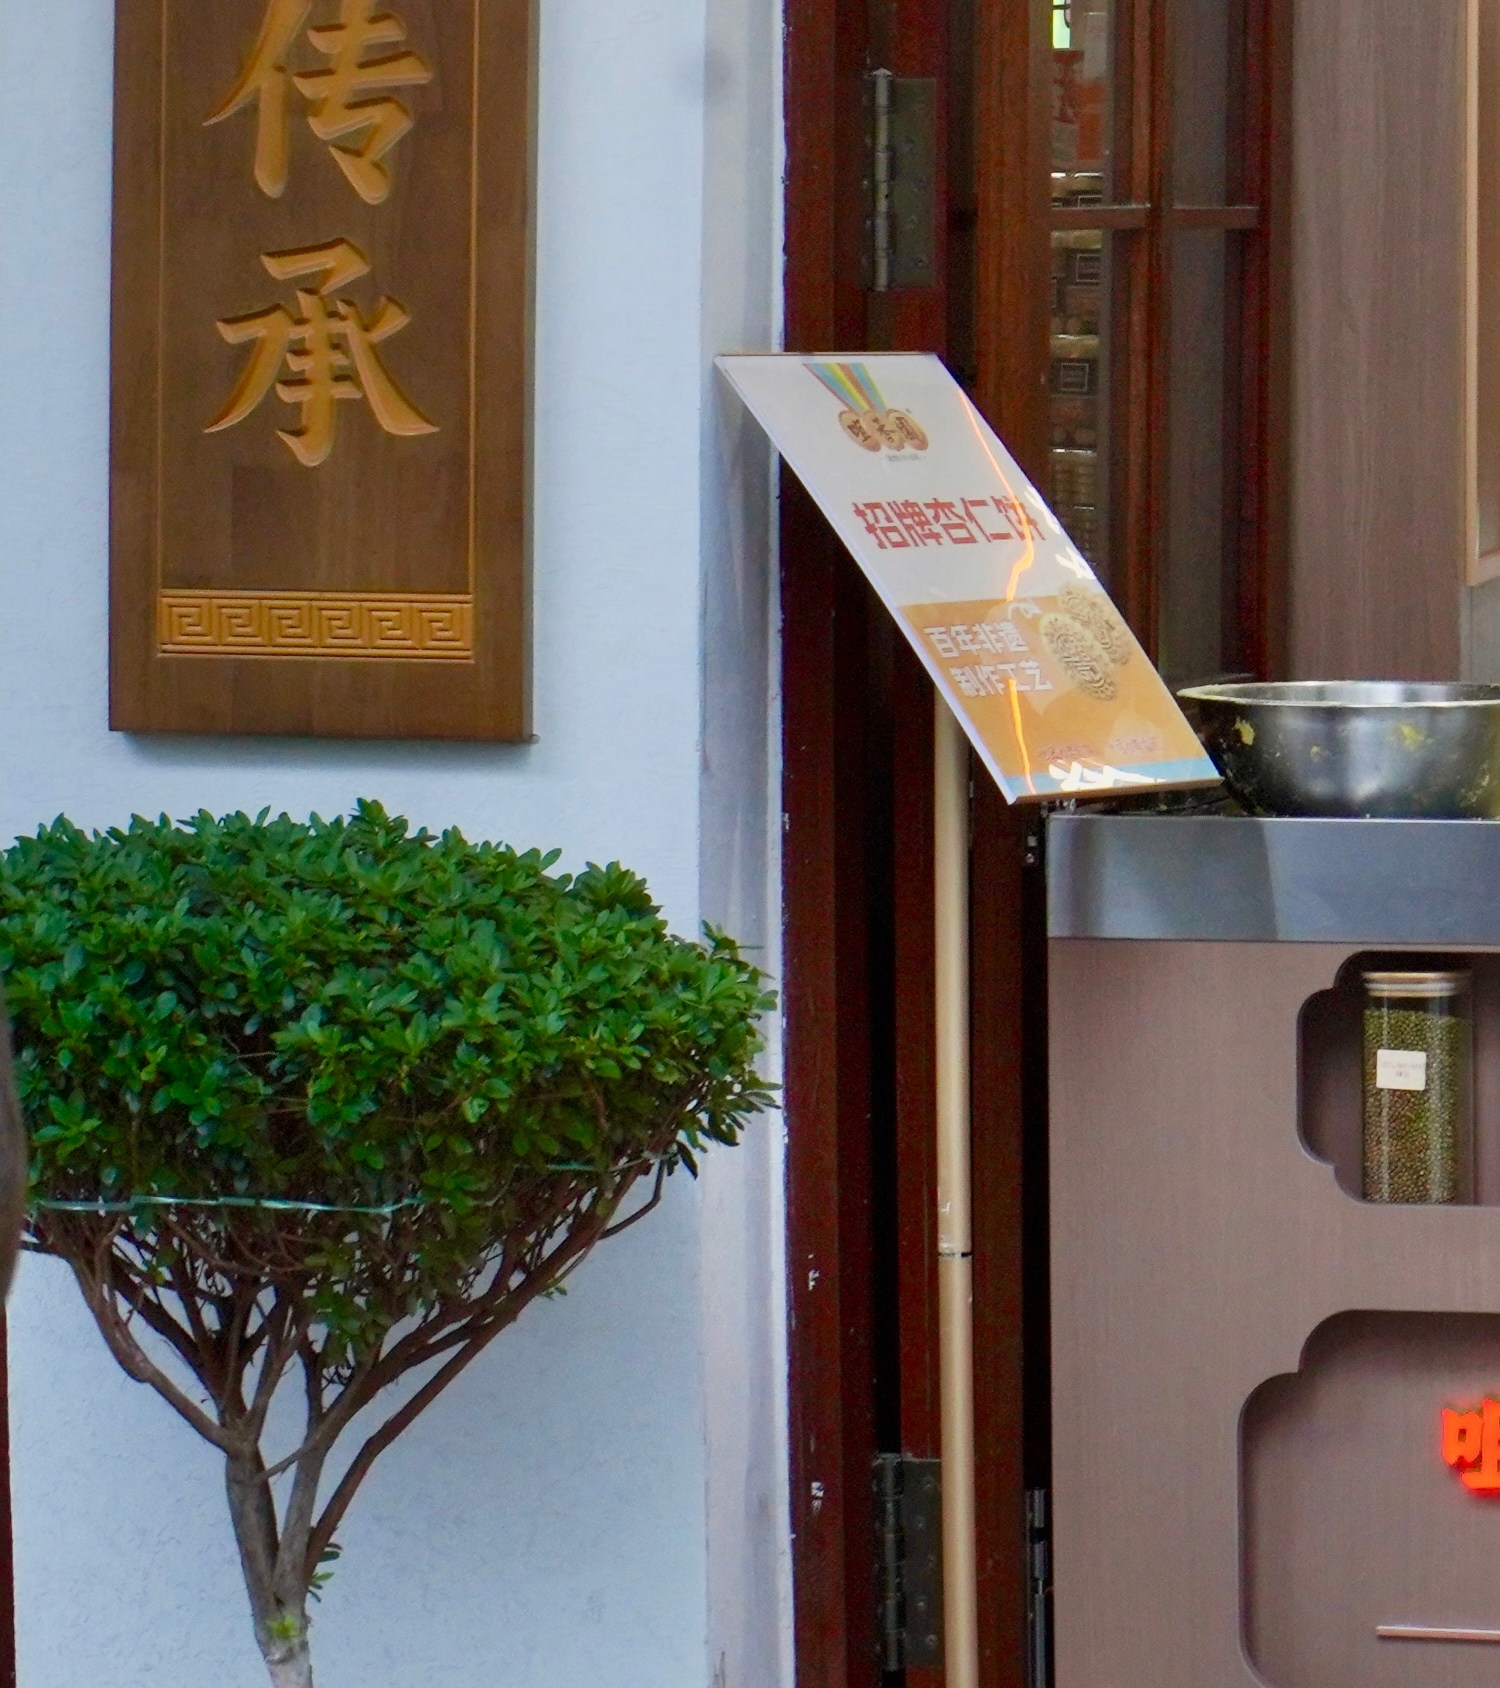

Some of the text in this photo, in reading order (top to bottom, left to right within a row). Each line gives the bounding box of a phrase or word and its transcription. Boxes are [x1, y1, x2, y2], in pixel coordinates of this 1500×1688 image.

[853, 496, 1046, 550] 招牌杏仁饼
[925, 623, 1032, 660] 百年非遗
[951, 661, 1053, 699] 制作工艺
